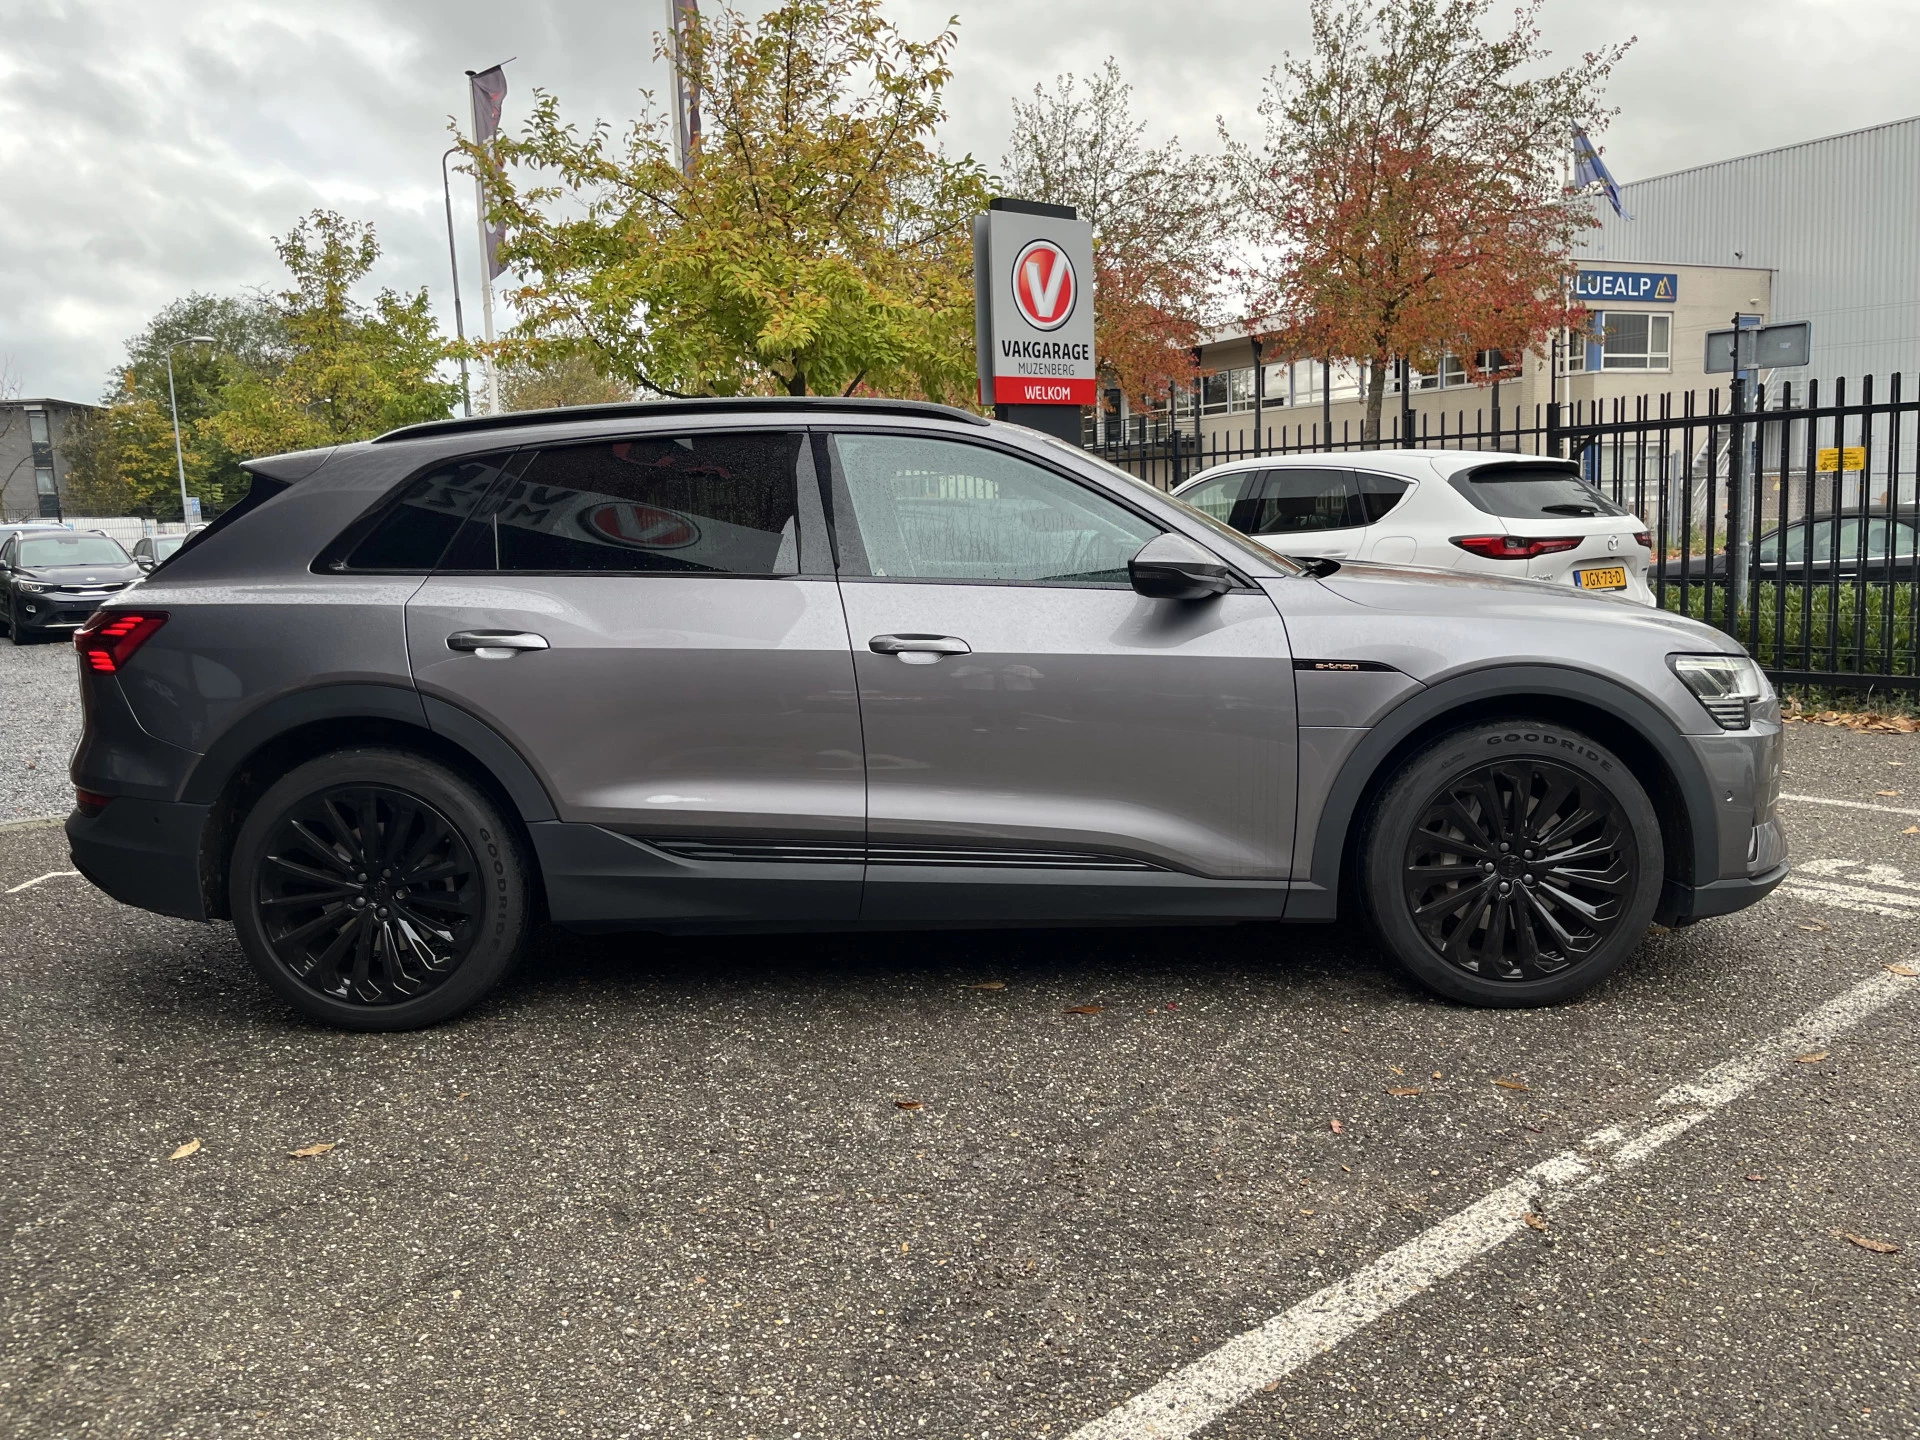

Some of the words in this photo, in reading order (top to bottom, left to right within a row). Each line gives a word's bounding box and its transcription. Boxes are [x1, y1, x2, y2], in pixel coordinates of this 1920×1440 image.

[1001, 339, 1089, 361] VAKGARAGE
[1018, 362, 1075, 376] MUZENBERG
[1024, 385, 1071, 400] WELKOM
[1585, 570, 1622, 587] JGX-73-D
[1315, 662, 1359, 670] e-tron
[1486, 733, 1613, 772] GOODRIDE
